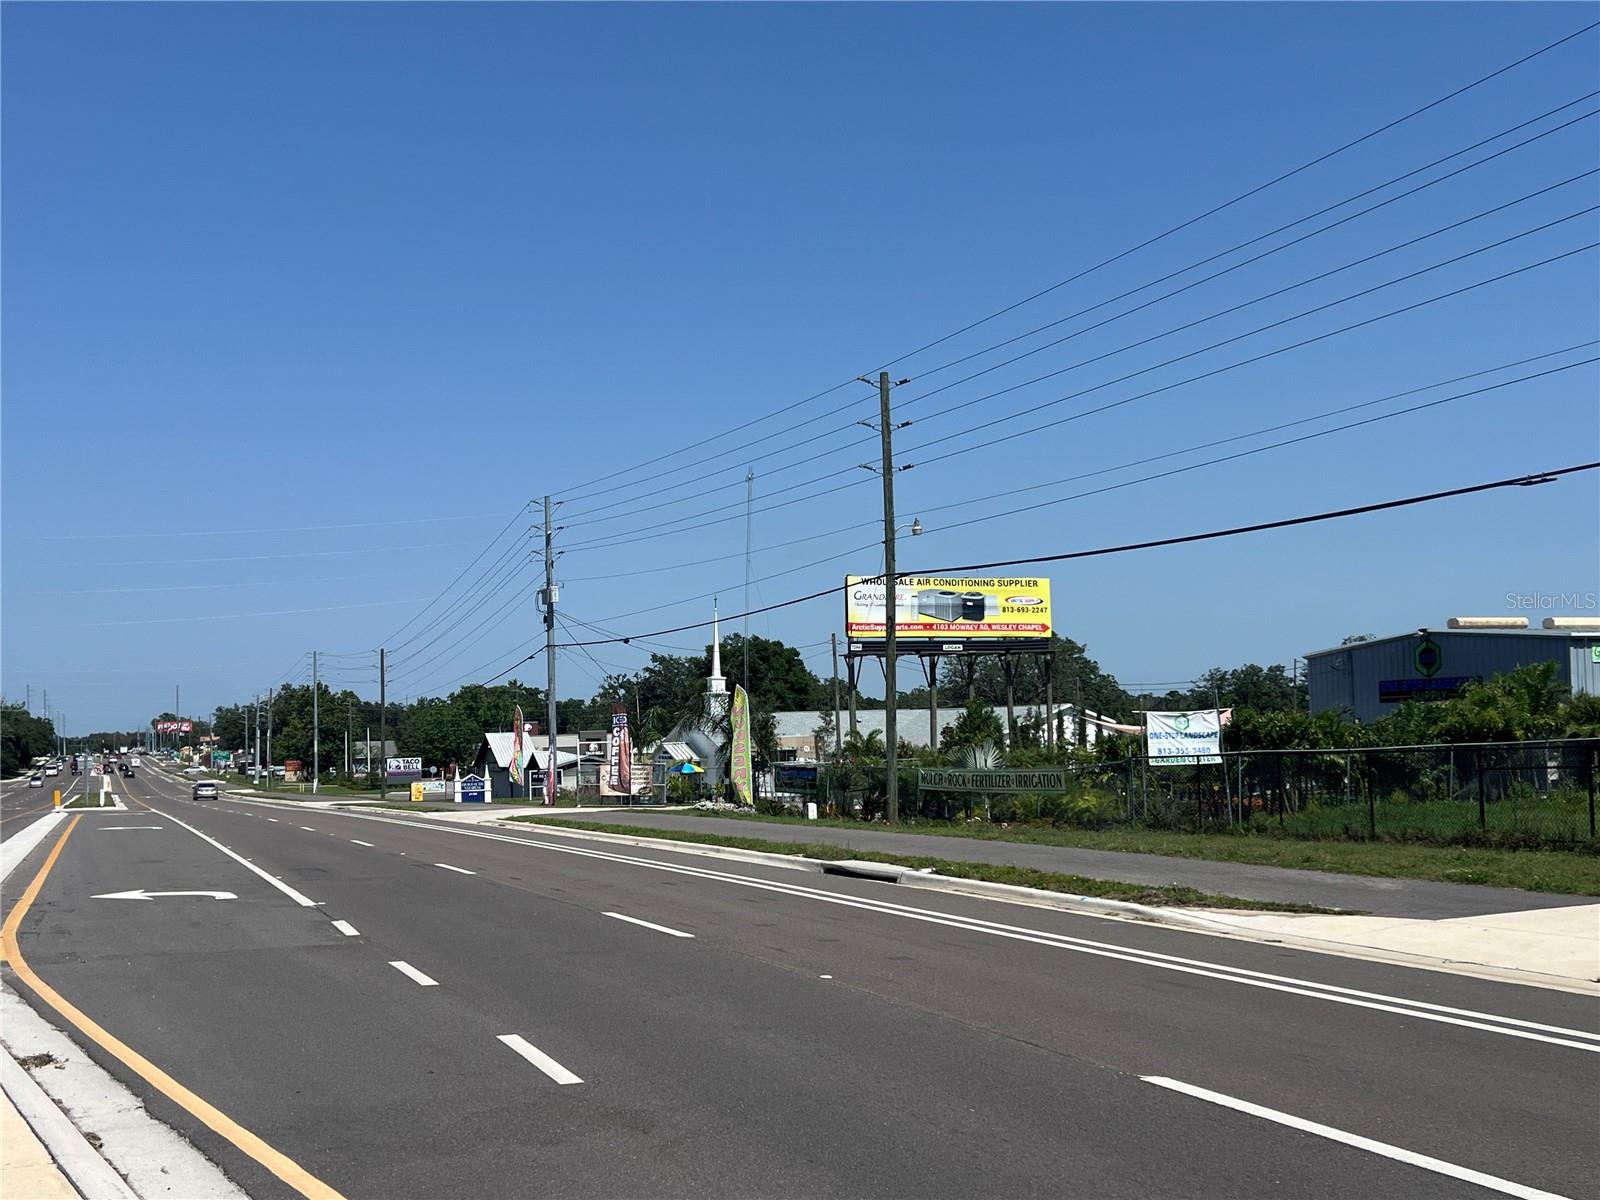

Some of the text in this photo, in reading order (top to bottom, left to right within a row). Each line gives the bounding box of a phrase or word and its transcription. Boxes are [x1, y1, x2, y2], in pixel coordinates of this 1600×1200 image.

[861, 577, 1038, 587] WHOLSALE AIR CONDITIONING SUPPLIER
[1411, 689, 1448, 701] SUPPLY
[1180, 731, 1219, 740] LANDSCAPE
[610, 727, 621, 786] COFFEE
[947, 773, 967, 787] ROCK
[971, 773, 1011, 788] FERTILIZER
[1015, 773, 1063, 789] IRRIGATION
